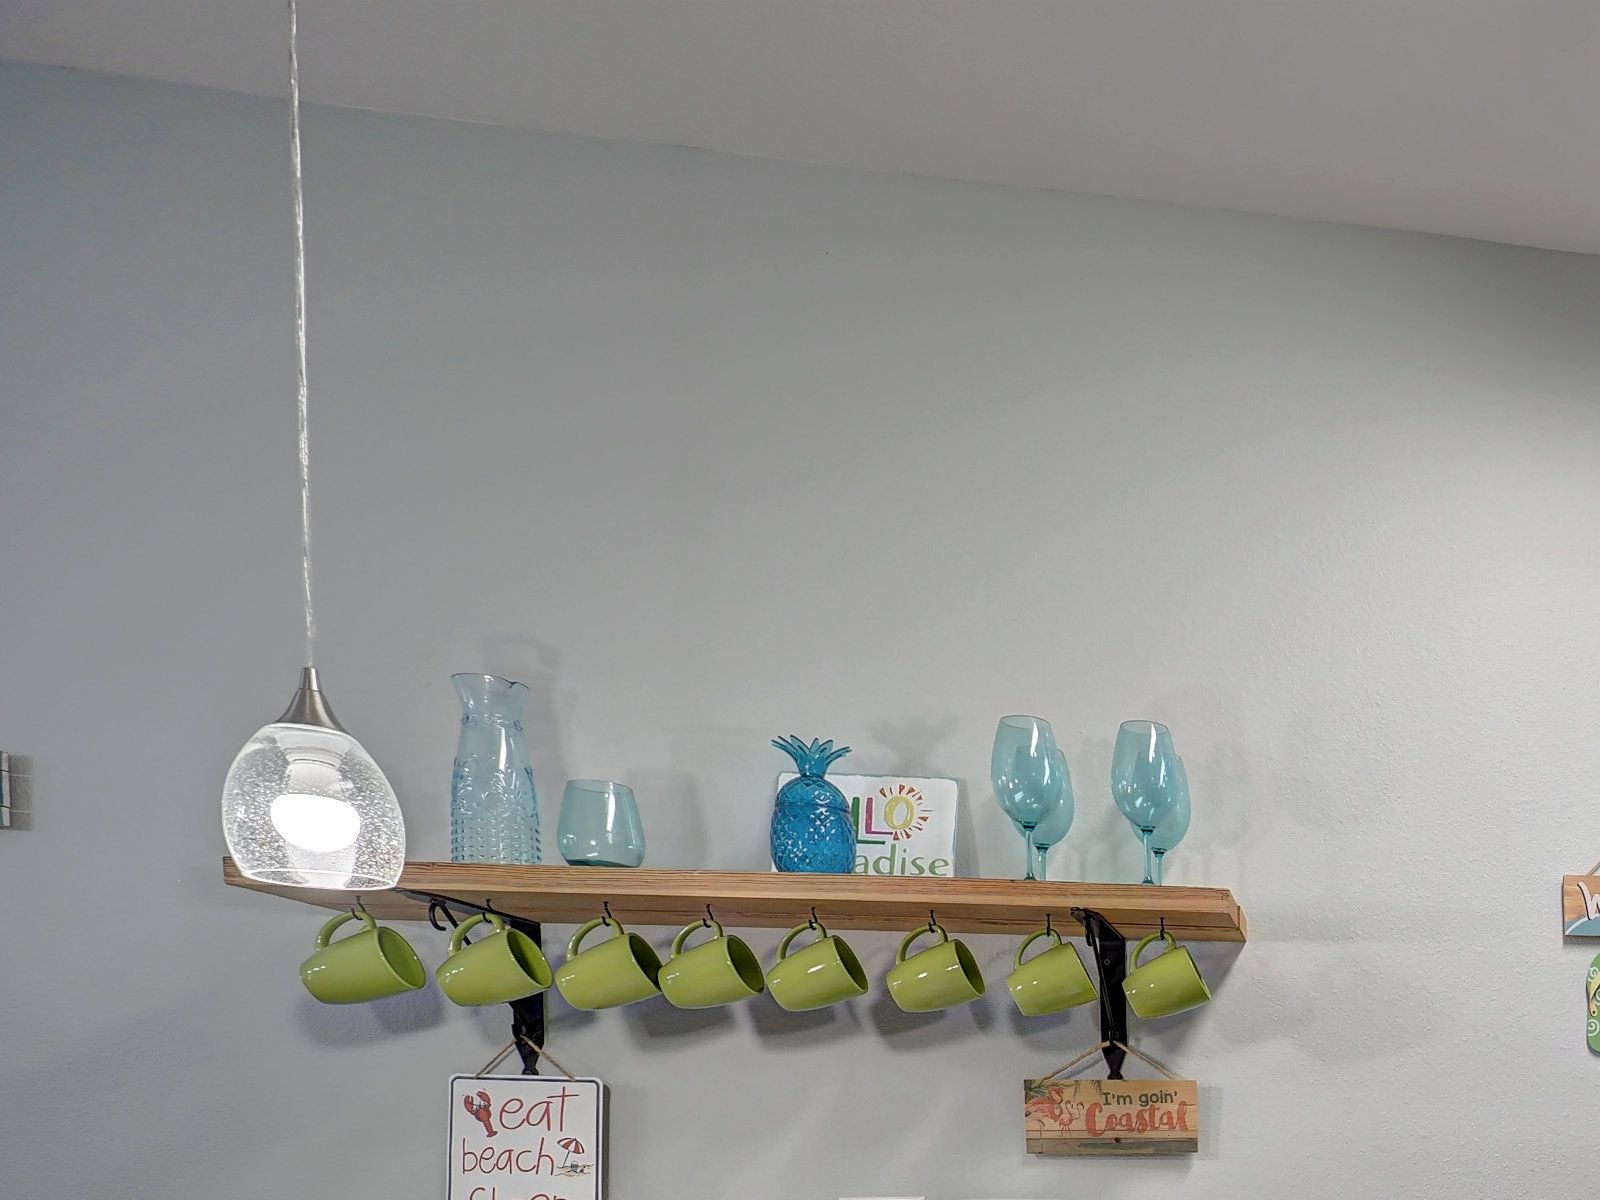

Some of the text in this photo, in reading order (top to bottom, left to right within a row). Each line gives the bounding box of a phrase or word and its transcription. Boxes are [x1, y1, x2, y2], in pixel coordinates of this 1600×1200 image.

[852, 795, 916, 845] LLO
[854, 844, 950, 876] adise
[499, 1086, 579, 1132] eat
[1102, 1090, 1178, 1107] I'm goin'
[1085, 1100, 1197, 1136] Coastal
[462, 1137, 554, 1176] beach
